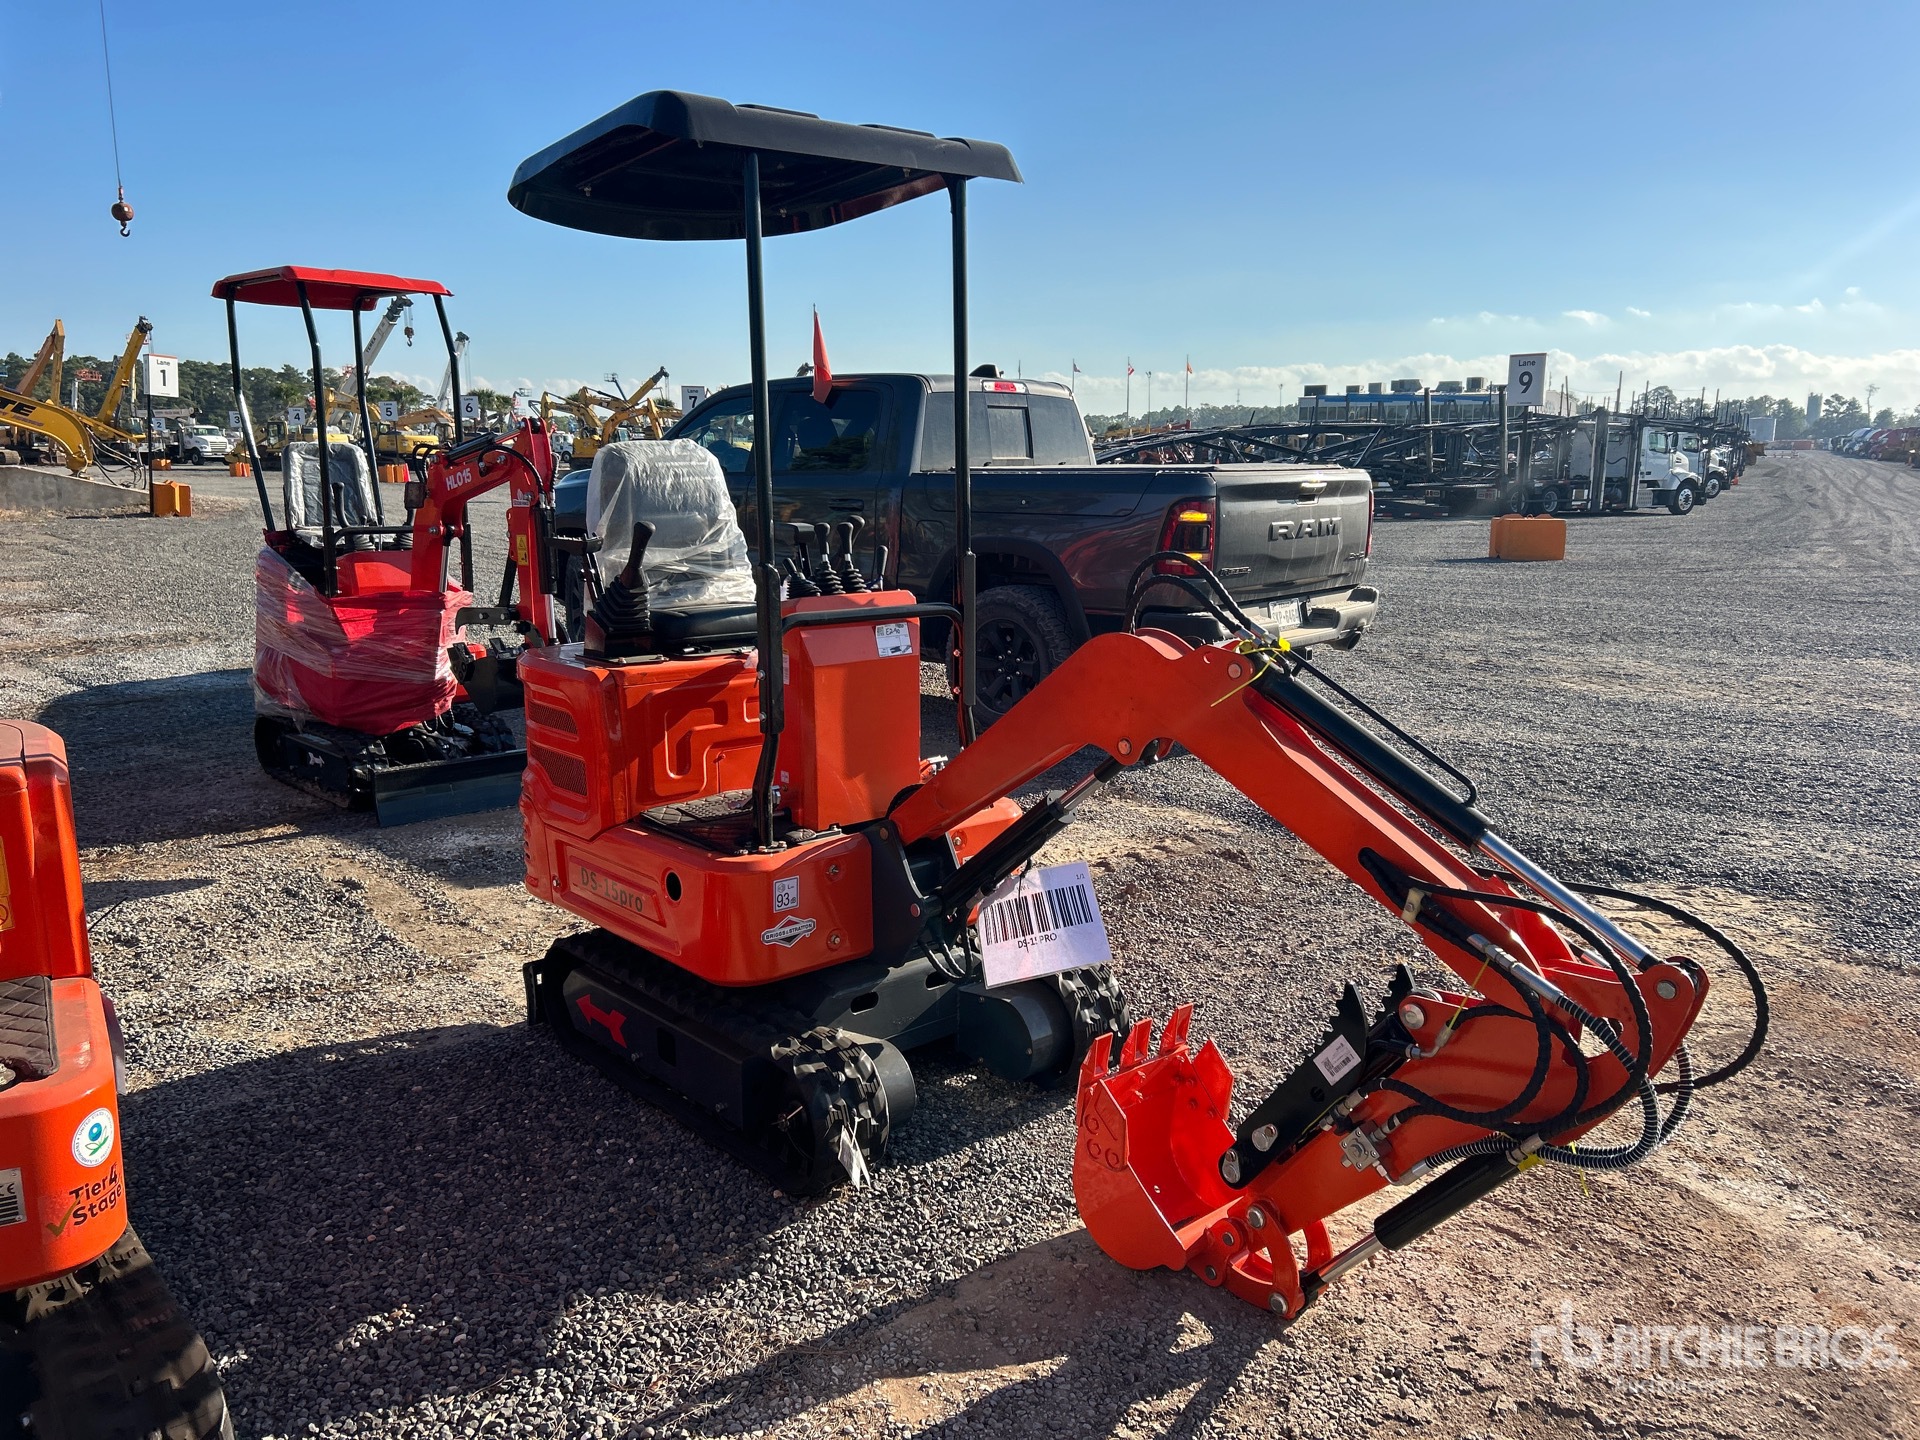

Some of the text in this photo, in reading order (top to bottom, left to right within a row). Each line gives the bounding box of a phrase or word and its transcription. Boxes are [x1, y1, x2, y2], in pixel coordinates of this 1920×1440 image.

[1518, 359, 1536, 367] Lane
[160, 369, 167, 387] 1
[1518, 371, 1533, 394] 9
[465, 402, 474, 413] 6
[688, 396, 698, 408] 7
[294, 412, 301, 421] 4
[385, 407, 393, 417] 5
[234, 416, 240, 424] 3
[1268, 516, 1342, 543] RAM
[581, 867, 643, 912] DS-15pro
[776, 892, 790, 908] 93
[1039, 932, 1058, 944] PRO
[72, 1183, 122, 1226] Stage
